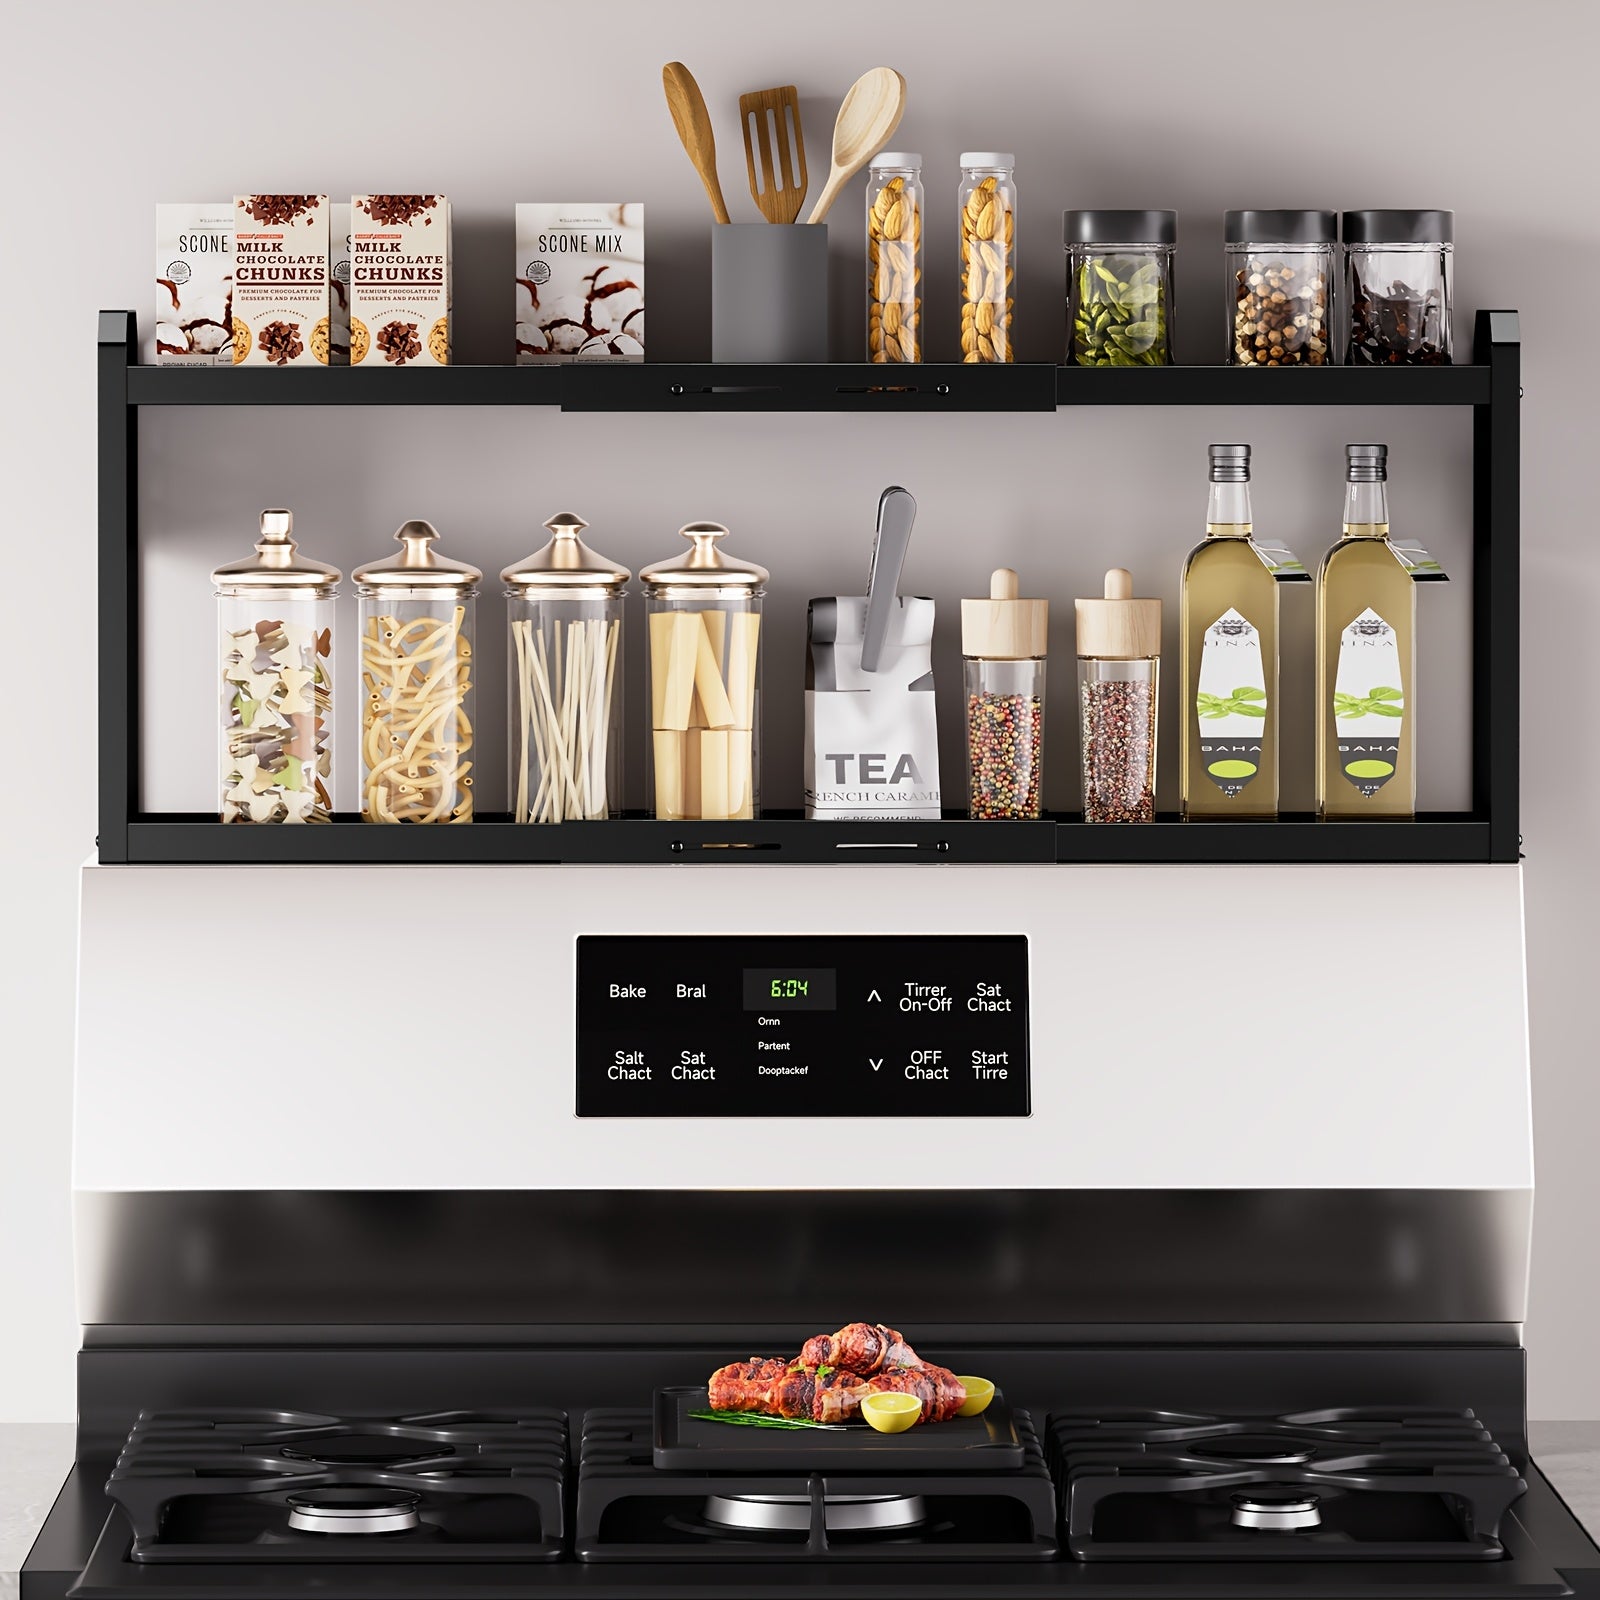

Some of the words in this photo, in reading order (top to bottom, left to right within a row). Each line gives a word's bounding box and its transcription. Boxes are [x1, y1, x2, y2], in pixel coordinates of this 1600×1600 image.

[180, 235, 228, 252] SCONE
[237, 243, 282, 252] MILK
[356, 243, 401, 252] MILK
[539, 235, 587, 252] SCONE
[596, 235, 621, 252] MIX
[237, 256, 324, 264] CHOCOLATE
[355, 256, 442, 264] CHOCOLATE
[236, 268, 324, 280] CHUNKS
[355, 268, 443, 280] CHUNKS
[825, 754, 924, 784] TEA
[610, 984, 646, 998] Bake
[677, 984, 706, 997] Bral
[772, 980, 807, 997] 6:04
[905, 983, 946, 996] Tirrer
[977, 983, 1001, 996] Sat
[900, 998, 952, 1011] On-Off
[968, 998, 1011, 1011] Chact
[759, 1042, 790, 1050] Partent
[616, 1051, 644, 1064] Salt
[681, 1051, 705, 1064] Sat
[911, 1051, 941, 1064] OFF
[972, 1051, 1008, 1064] Start
[608, 1066, 652, 1080] Chact
[672, 1066, 715, 1080] Chact
[905, 1066, 949, 1079] Chact
[972, 1066, 1007, 1079] Tirre
